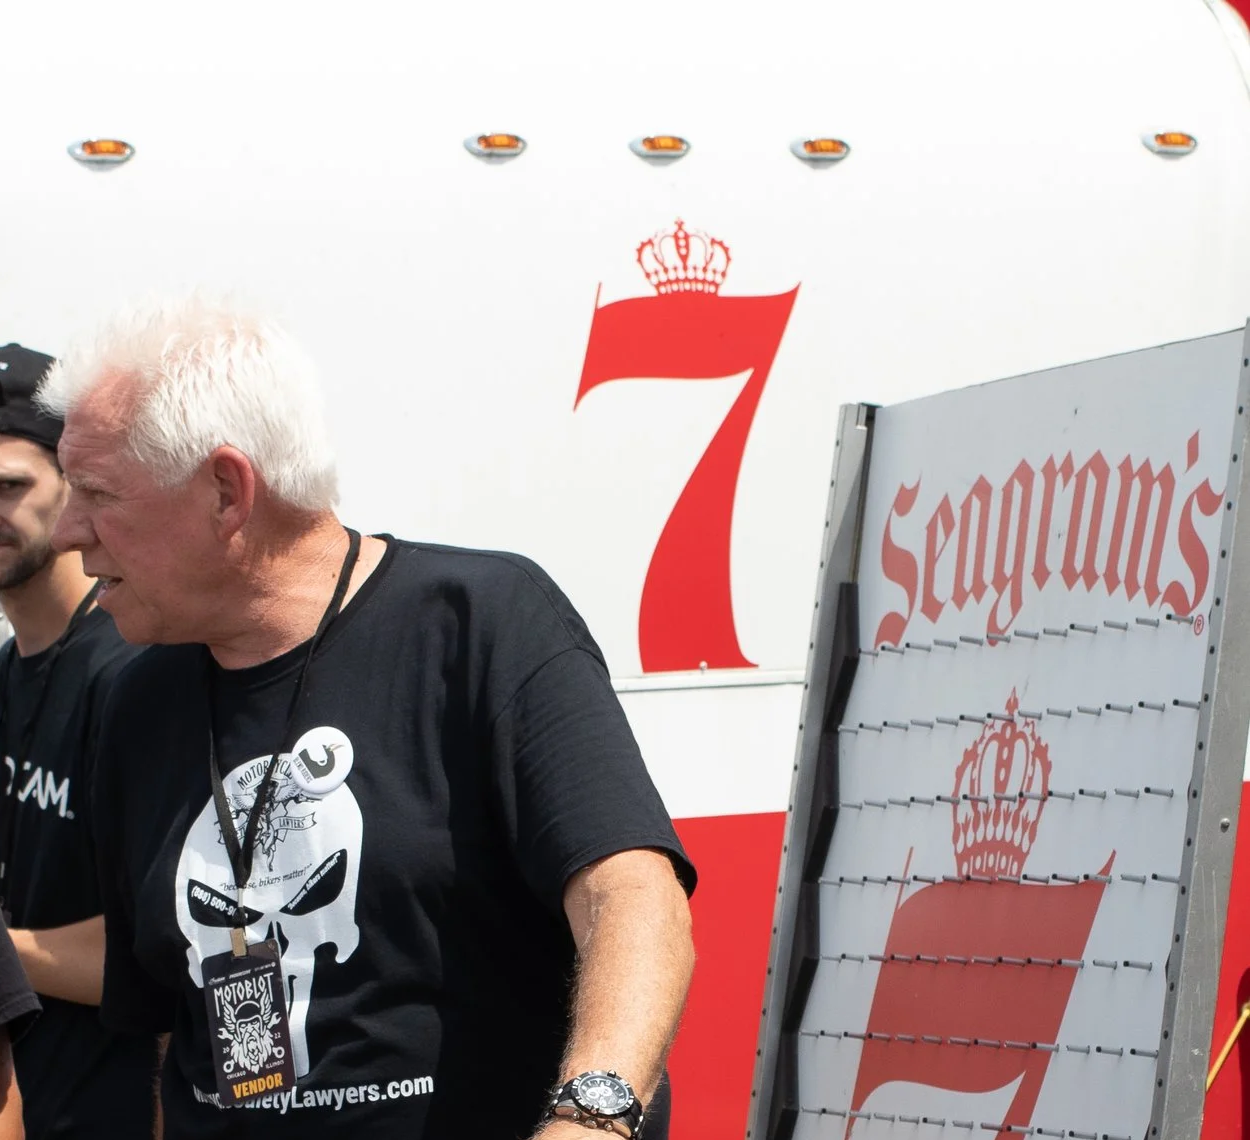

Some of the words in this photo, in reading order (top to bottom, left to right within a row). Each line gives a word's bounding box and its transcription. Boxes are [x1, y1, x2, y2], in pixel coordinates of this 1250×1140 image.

[574, 281, 802, 674] 7
[874, 429, 1227, 651] Seagram's
[213, 972, 274, 1018] MOTOBLOT
[226, 1070, 247, 1080] CHICAGO
[265, 1059, 285, 1070] ILLINOIS
[232, 1072, 283, 1099] VENDOR
